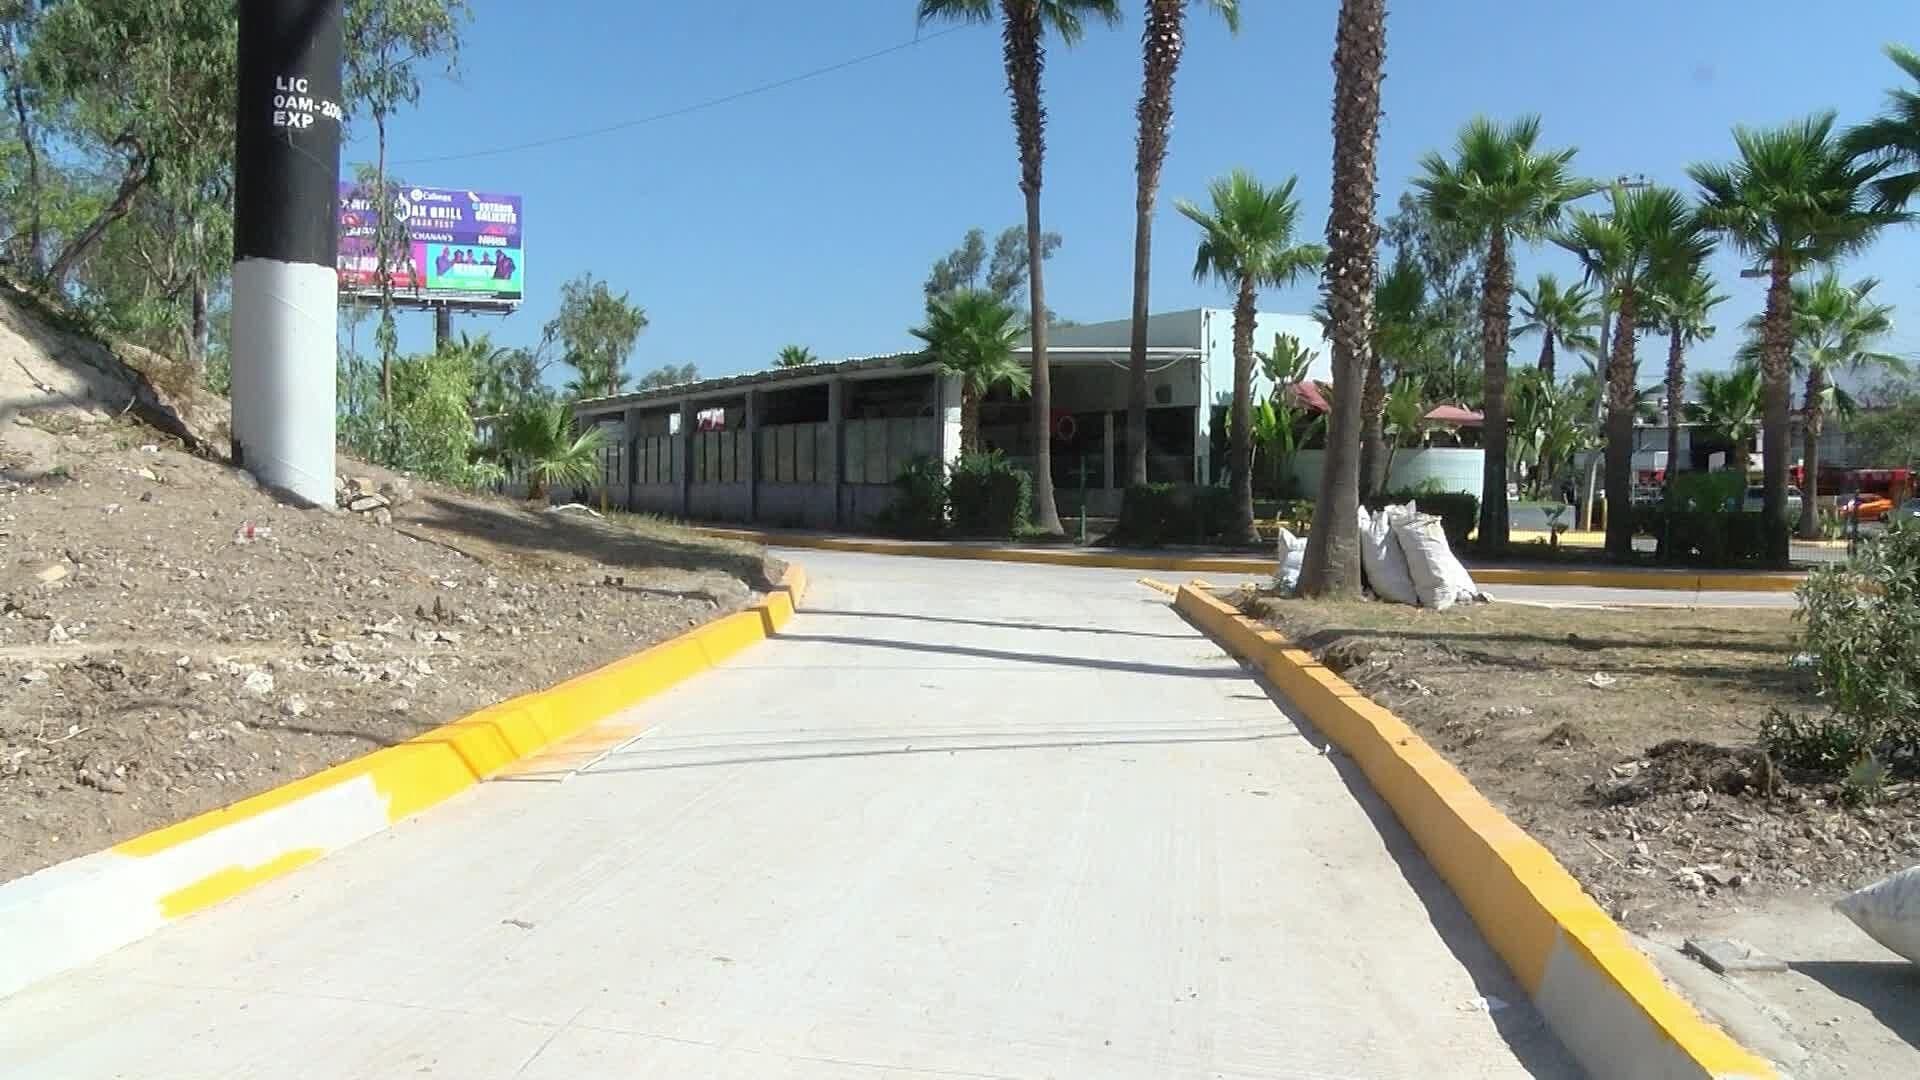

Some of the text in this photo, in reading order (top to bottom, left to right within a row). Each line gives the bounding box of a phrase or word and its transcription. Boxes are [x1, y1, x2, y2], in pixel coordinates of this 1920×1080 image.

[276, 76, 308, 93] LIC
[273, 111, 314, 128] EXP
[430, 206, 462, 221] GRILL
[434, 218, 454, 229] FEST
